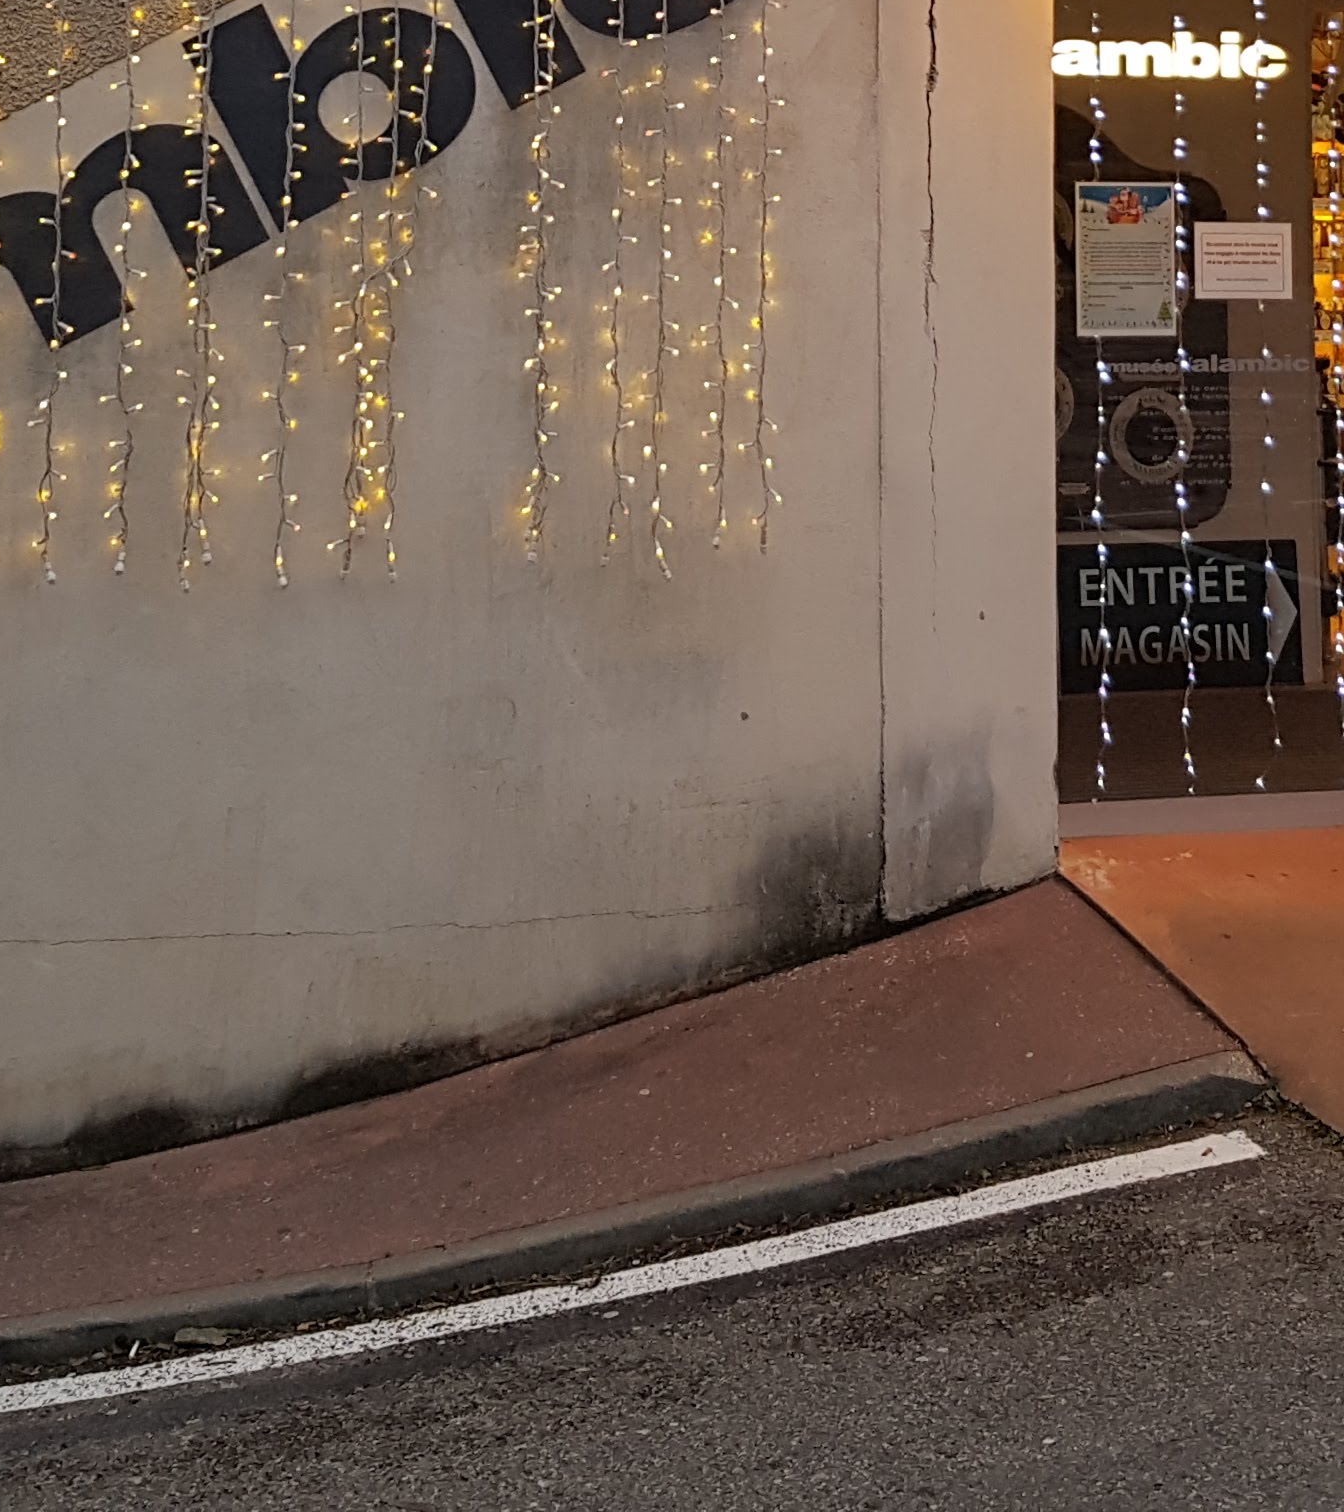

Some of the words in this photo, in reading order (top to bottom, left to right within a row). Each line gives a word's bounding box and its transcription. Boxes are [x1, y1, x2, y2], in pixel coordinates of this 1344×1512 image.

[1051, 31, 1288, 80] ambic
[1079, 557, 1248, 607] ENTRÉE
[1080, 622, 1251, 667] MAGASIN
